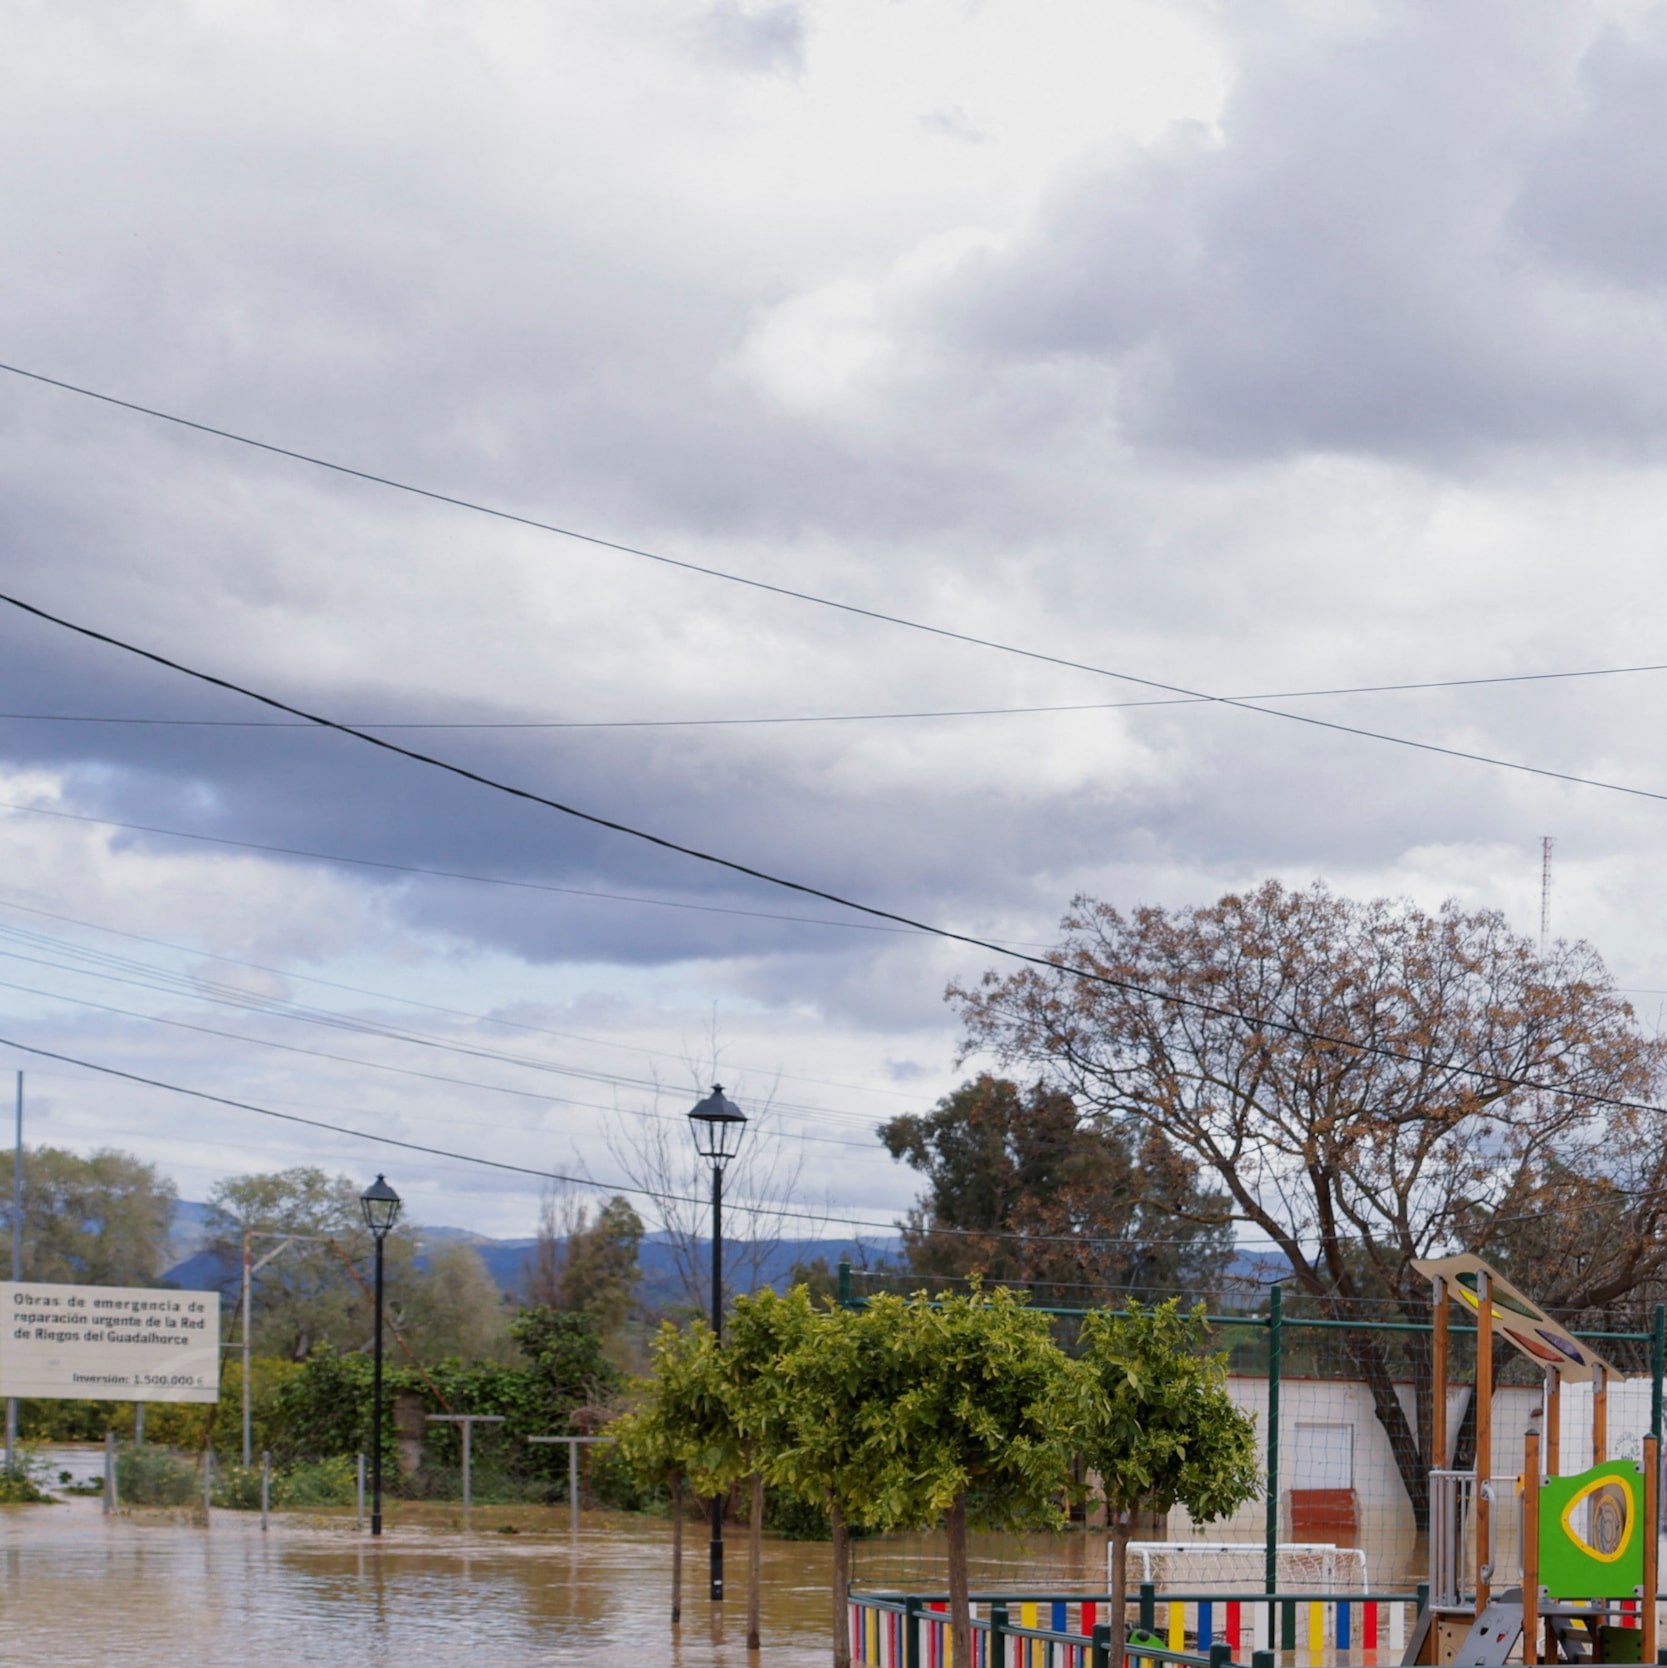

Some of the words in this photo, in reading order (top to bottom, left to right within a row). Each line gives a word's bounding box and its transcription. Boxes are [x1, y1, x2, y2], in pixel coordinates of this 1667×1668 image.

[13, 1293, 60, 1306] Obras
[67, 1296, 85, 1308] de
[93, 1299, 180, 1312] emergencia
[187, 1301, 205, 1313] de
[13, 1312, 87, 1325] reparación
[92, 1316, 141, 1328] urgente
[145, 1316, 161, 1327] de
[165, 1317, 176, 1328] la
[181, 1317, 204, 1329] Red
[14, 1328, 30, 1339] de
[35, 1328, 79, 1343] Riegos
[83, 1330, 103, 1342] del
[107, 1331, 189, 1345] Guadalhorce
